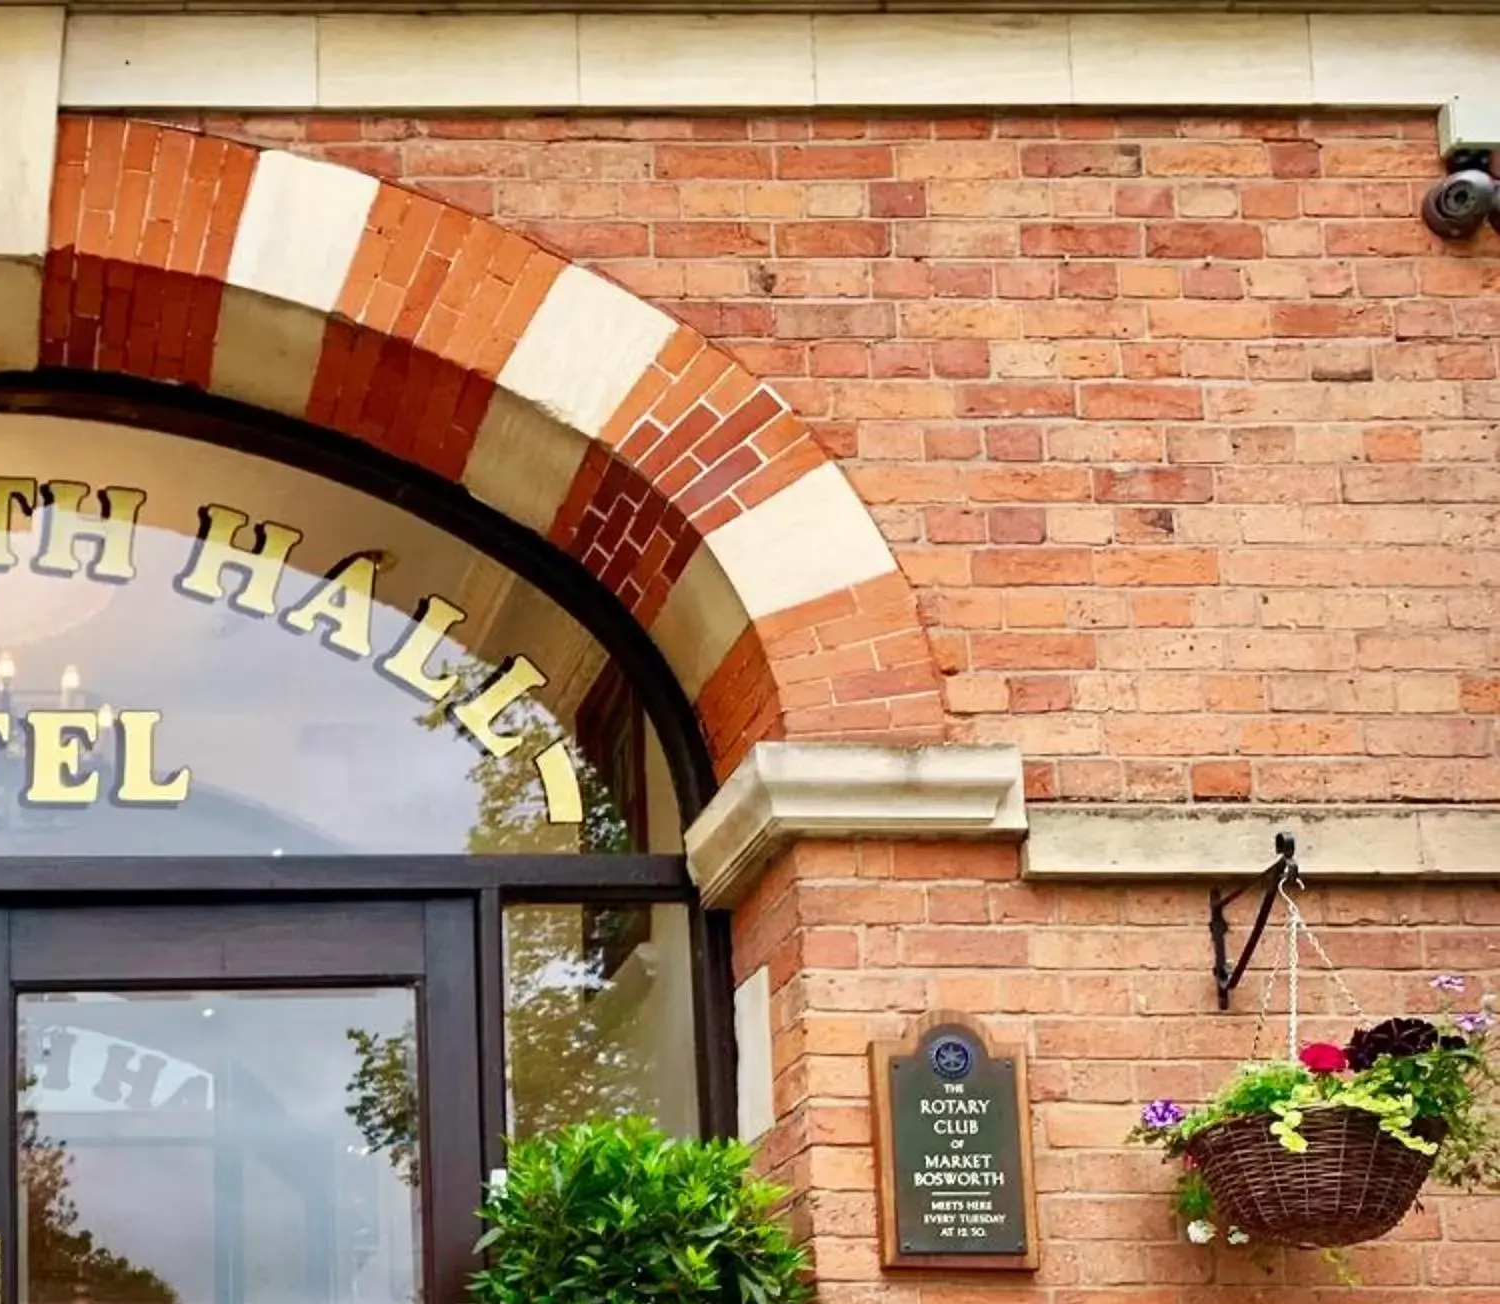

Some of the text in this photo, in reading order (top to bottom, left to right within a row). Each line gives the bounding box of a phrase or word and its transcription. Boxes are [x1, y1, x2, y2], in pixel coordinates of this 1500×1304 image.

[173, 503, 549, 758] HALL
[943, 1083, 964, 1094] THE
[920, 1099, 991, 1115] ROTARY
[933, 1120, 979, 1135] CLUB
[950, 1139, 965, 1149] OF
[924, 1155, 993, 1169] MARKET
[913, 1172, 1005, 1187] BOSWORTH
[931, 1200, 993, 1211] MEETS HERE
[923, 1213, 1006, 1224] EVERY TUESDAY
[940, 1227, 955, 1237] AT
